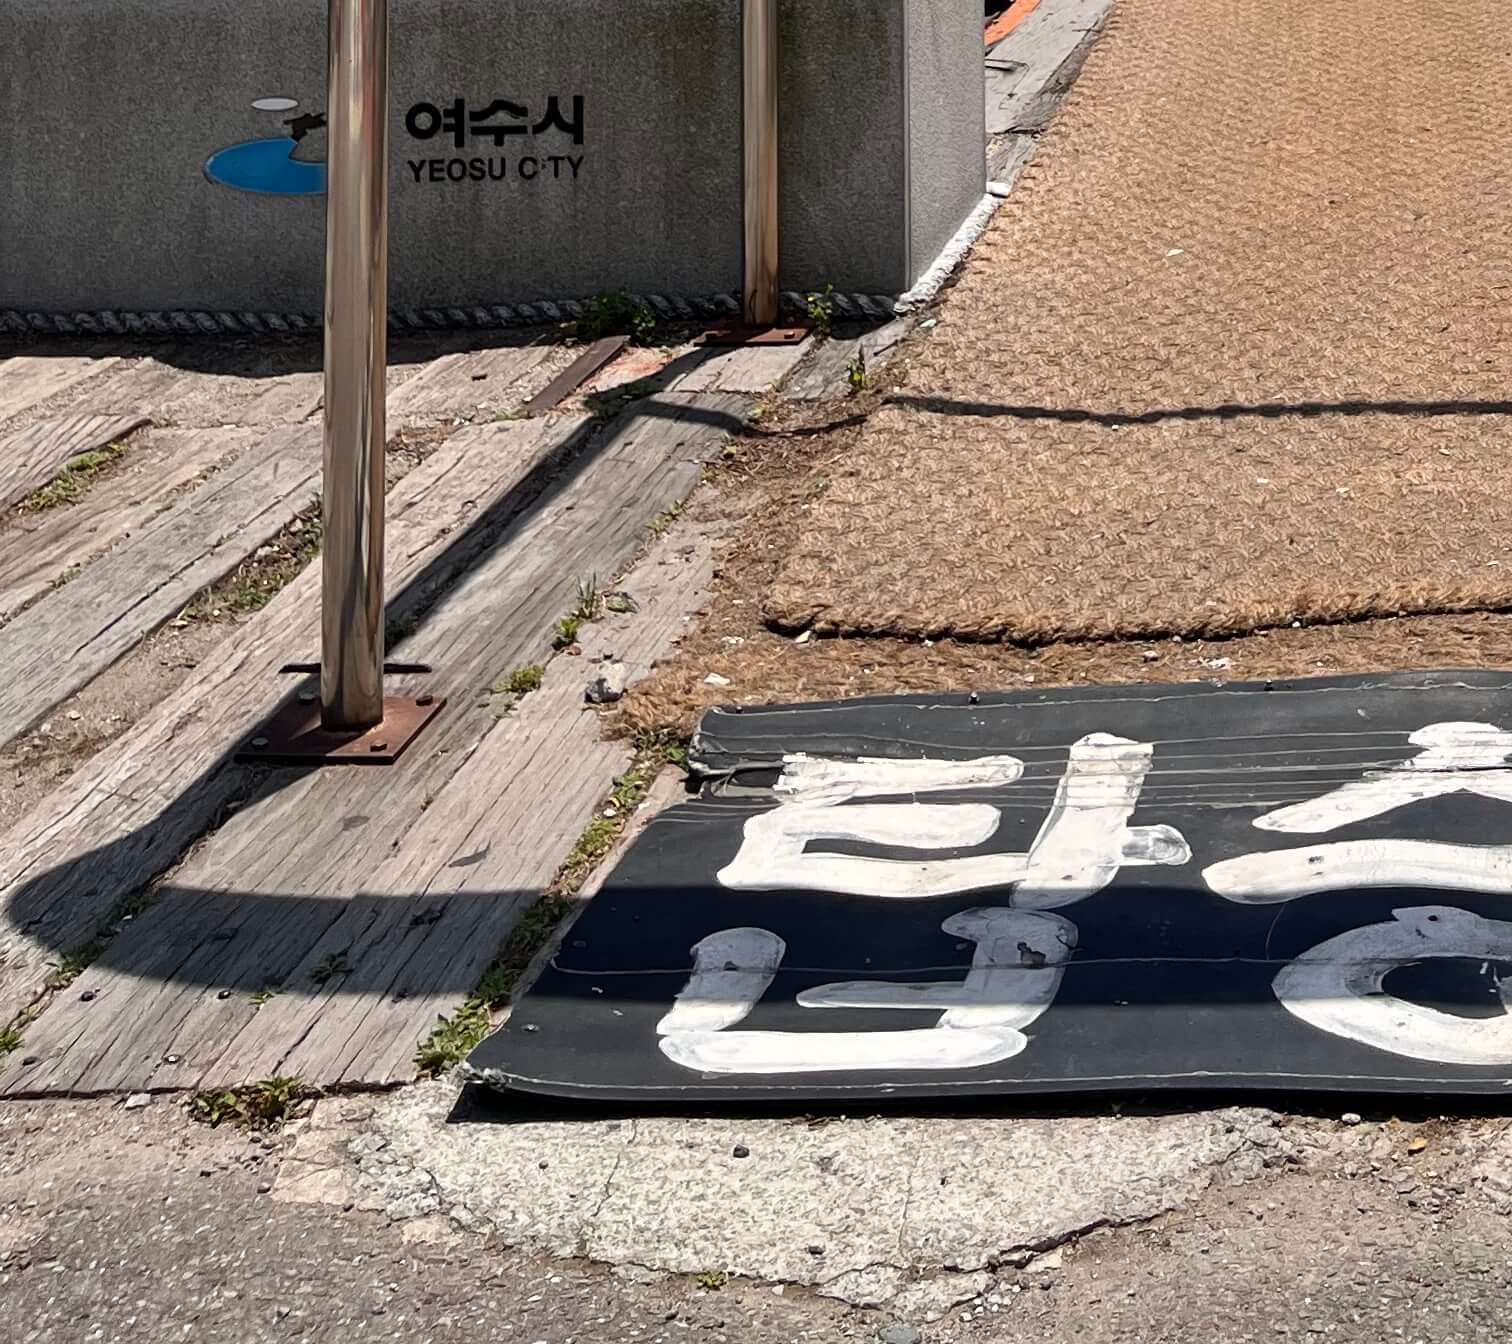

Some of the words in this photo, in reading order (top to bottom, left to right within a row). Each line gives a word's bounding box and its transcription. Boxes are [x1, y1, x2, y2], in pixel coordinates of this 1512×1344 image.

[405, 95, 584, 148] 여수시
[407, 157, 506, 183] YEOSU
[518, 155, 584, 180] CTY
